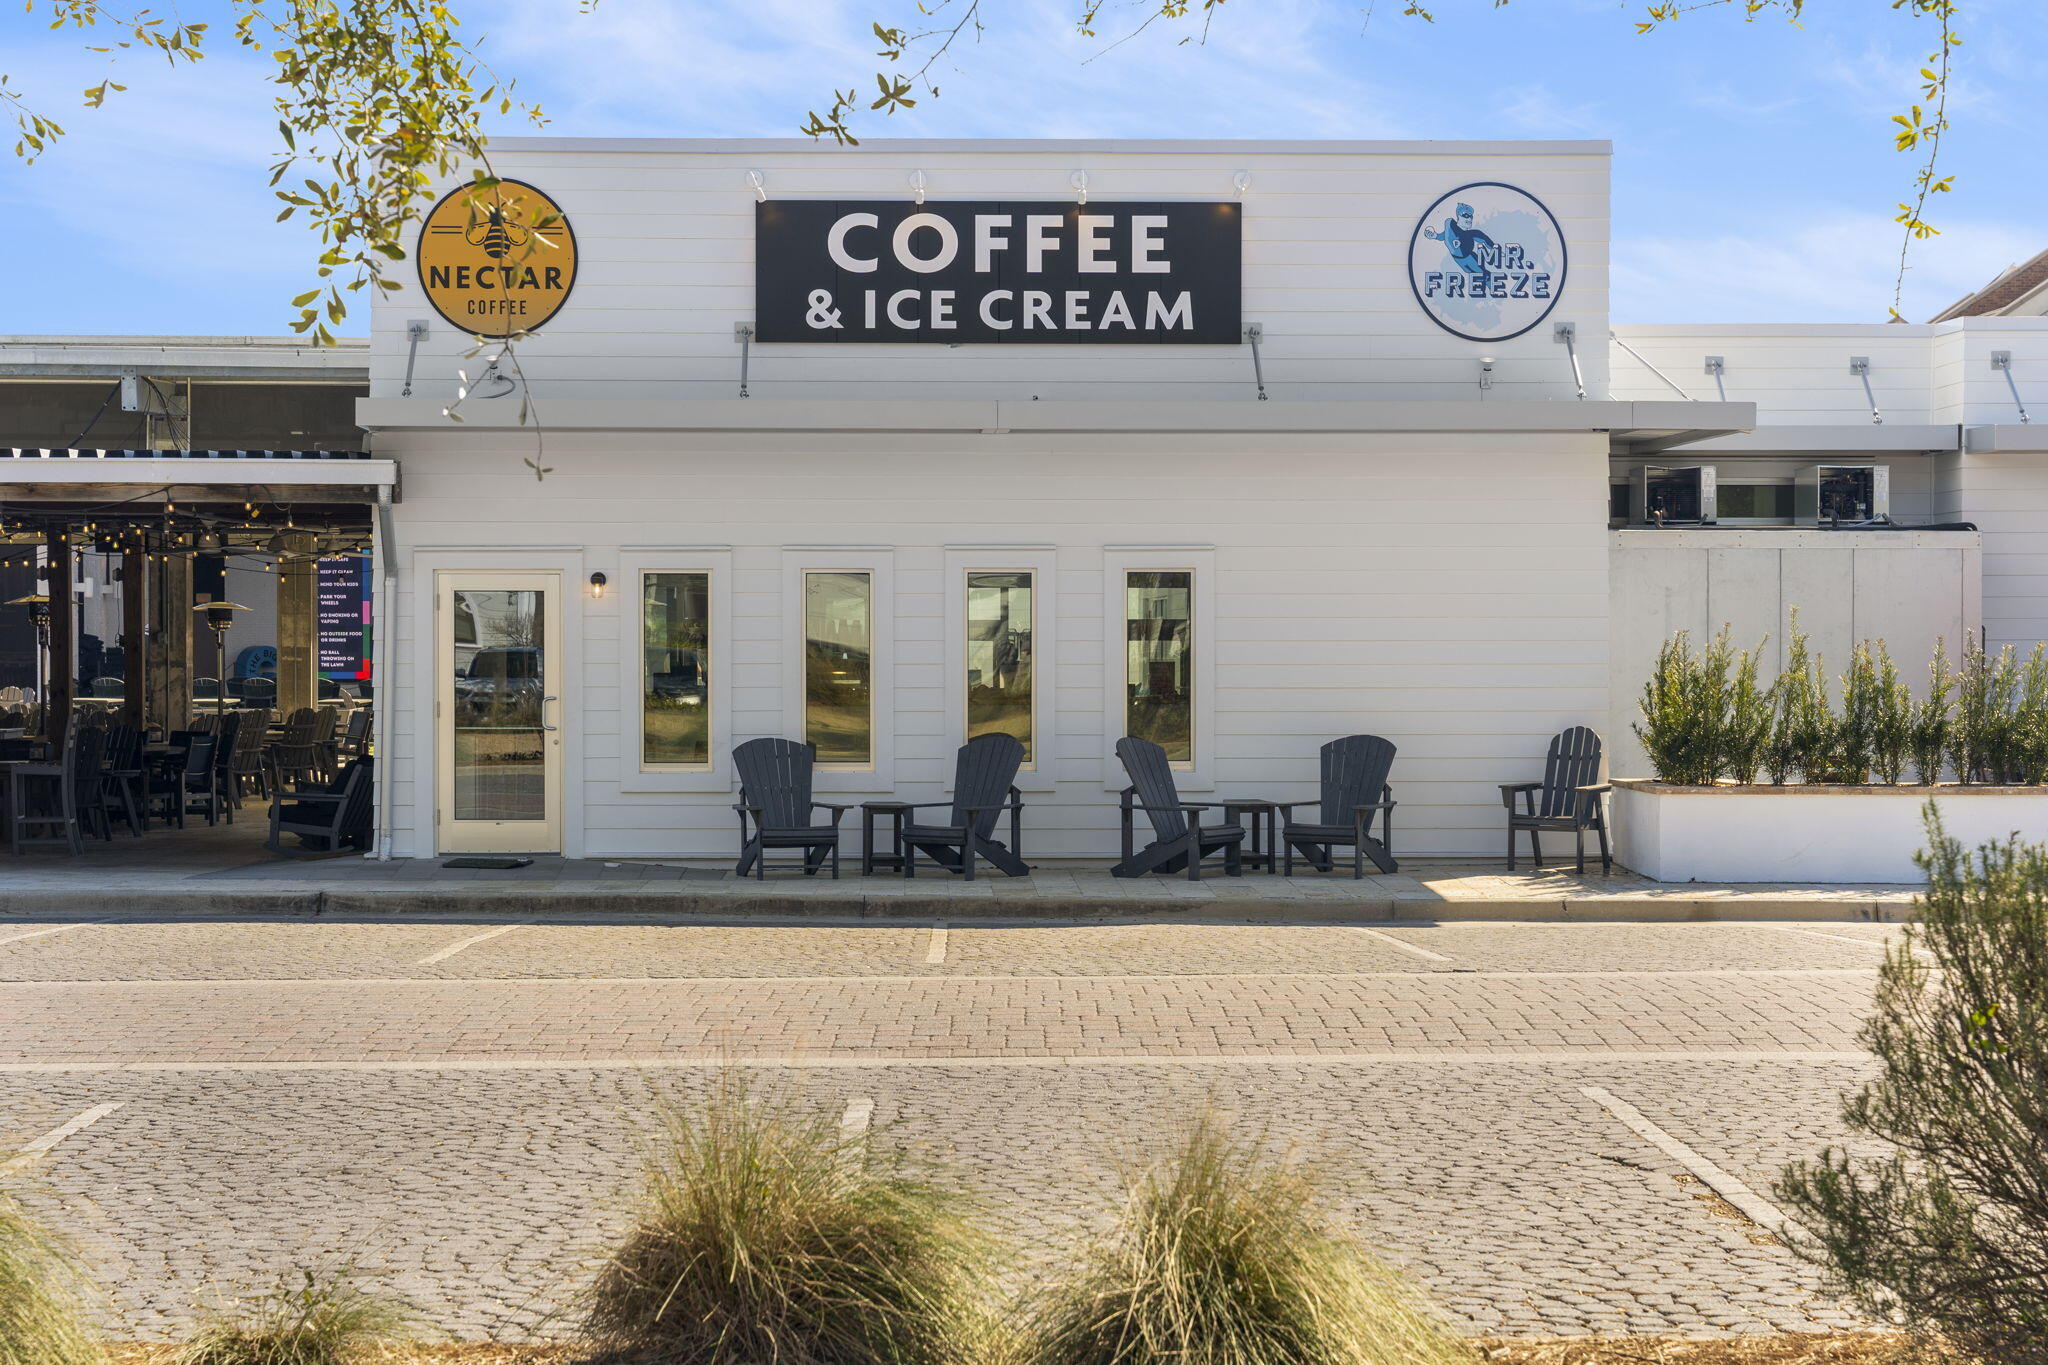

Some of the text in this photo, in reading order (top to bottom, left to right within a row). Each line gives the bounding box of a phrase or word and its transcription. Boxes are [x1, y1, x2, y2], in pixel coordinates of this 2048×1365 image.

[827, 212, 1171, 274] COFFEE
[1477, 242, 1534, 270] MR.
[429, 266, 564, 290] NECTAR
[1424, 271, 1551, 299] FREEZE
[467, 299, 527, 315] COFFEE
[805, 288, 1194, 330] & ICE CREAM
